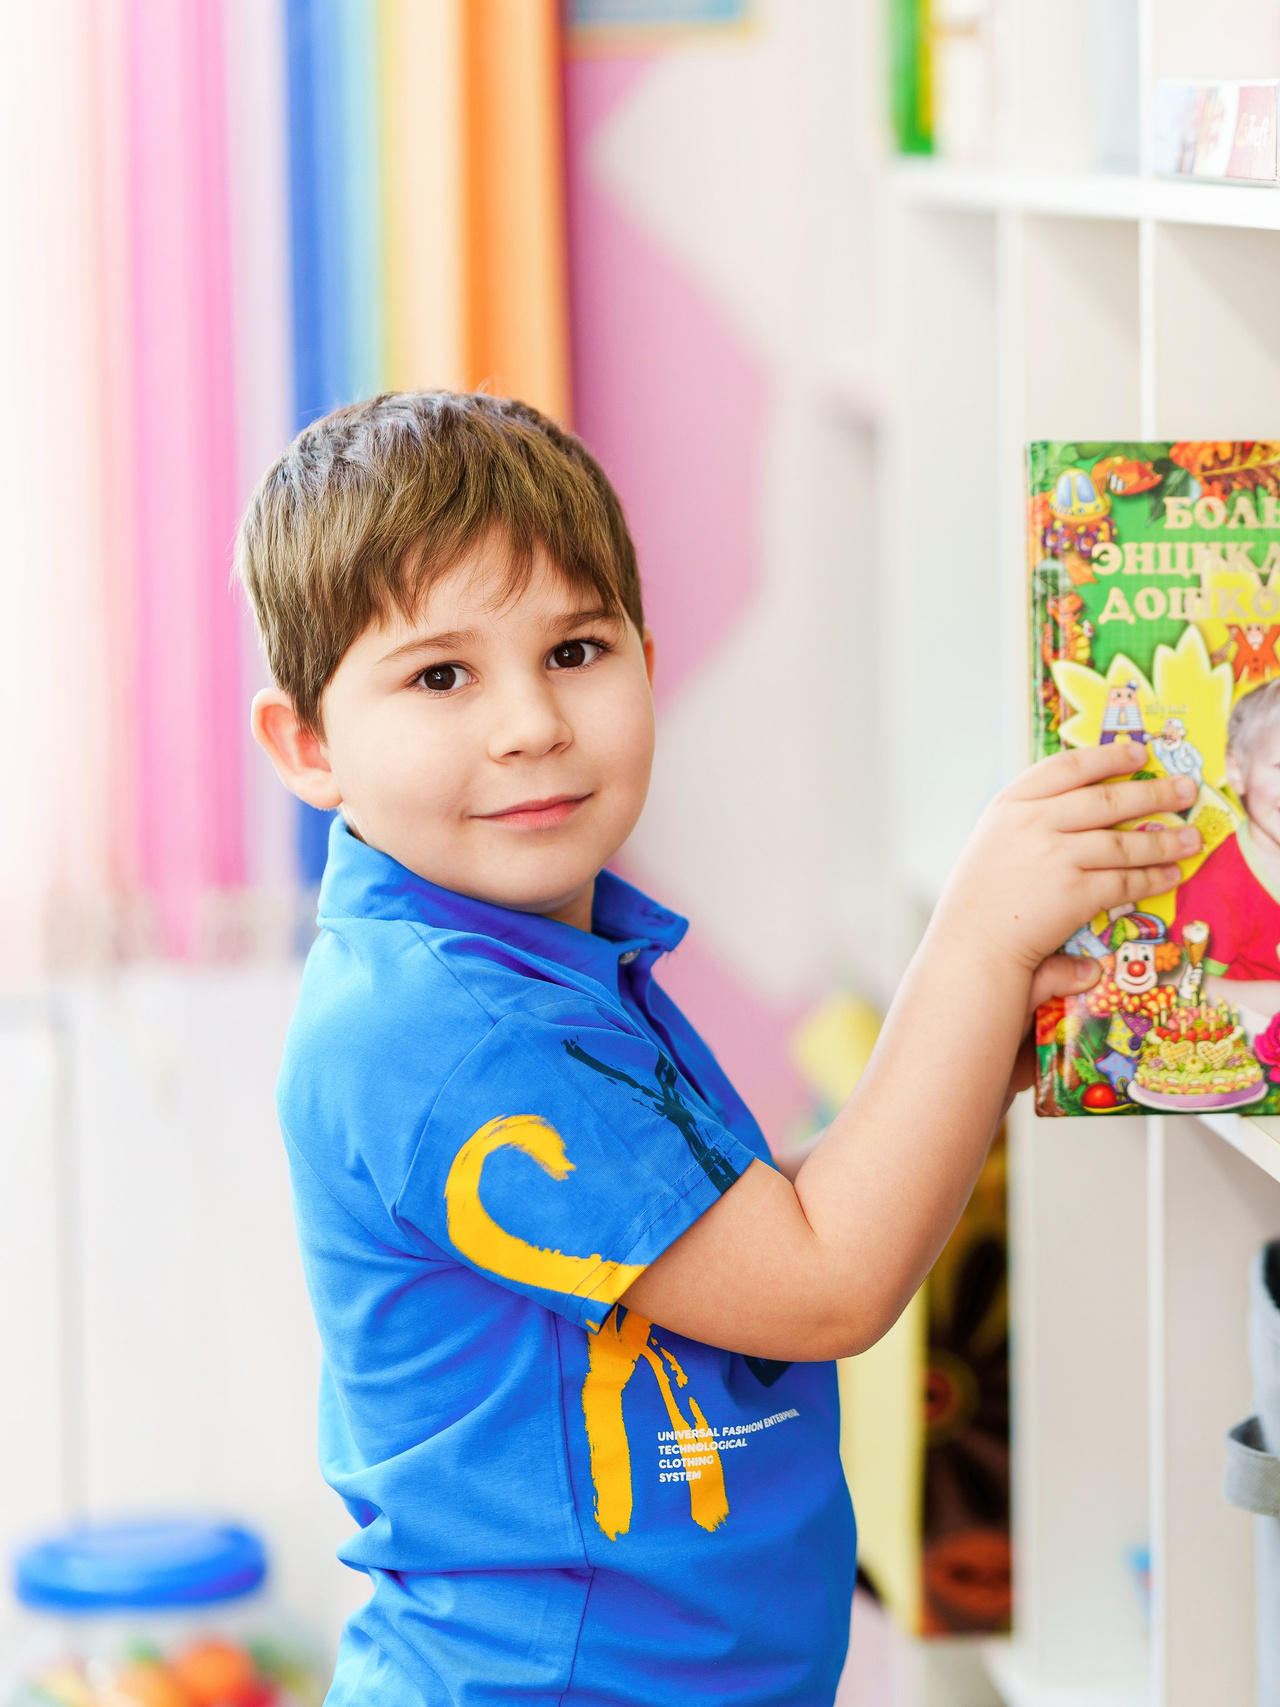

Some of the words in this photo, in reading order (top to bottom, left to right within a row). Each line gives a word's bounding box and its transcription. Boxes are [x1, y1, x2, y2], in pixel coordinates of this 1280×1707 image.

[658, 1427, 720, 1441] UNIVERSAL
[722, 1419, 764, 1436] FASHION
[658, 1438, 748, 1455] TECHNOLOGICAL
[658, 1455, 714, 1469] CLOTHING
[659, 1470, 701, 1483] SYSTEM
